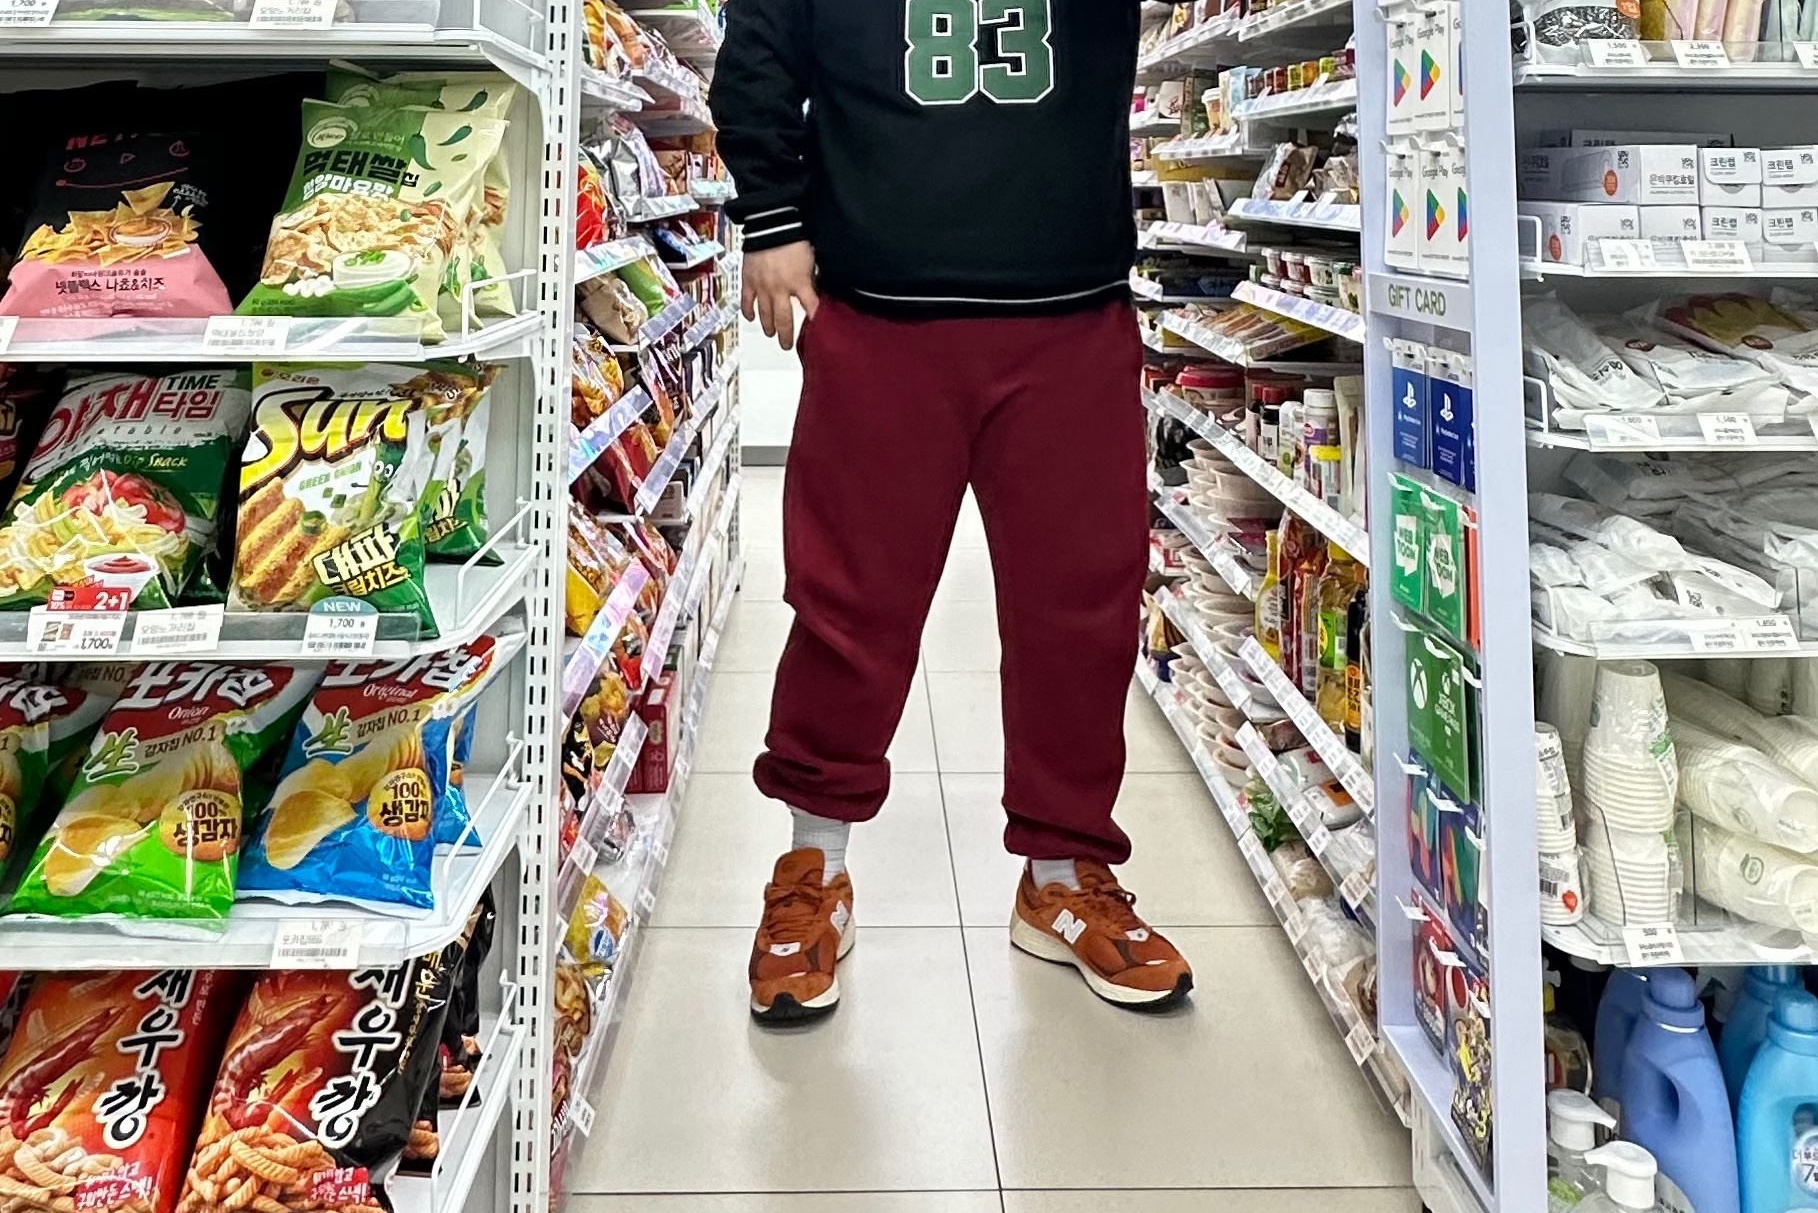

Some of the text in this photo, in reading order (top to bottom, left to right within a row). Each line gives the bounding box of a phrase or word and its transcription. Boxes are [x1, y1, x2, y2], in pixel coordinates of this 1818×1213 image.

[1388, 283, 1448, 317] GIFT CARD
[166, 373, 221, 391] TIME
[152, 391, 224, 420] 타임
[149, 451, 188, 468] Snack
[299, 471, 331, 491] GREEN
[312, 523, 398, 586] 대파
[95, 591, 130, 611] 2+1
[323, 601, 362, 612] NEW
[328, 617, 355, 629] 1,700
[363, 682, 419, 699] Original
[168, 705, 209, 720] Onion
[356, 707, 421, 738] 감자칩 NO.1
[144, 724, 217, 759] 감자칩 NO.1
[174, 819, 237, 848] 생감자
[94, 968, 193, 1148] 새우깡
[310, 965, 412, 1149] 새우깡
